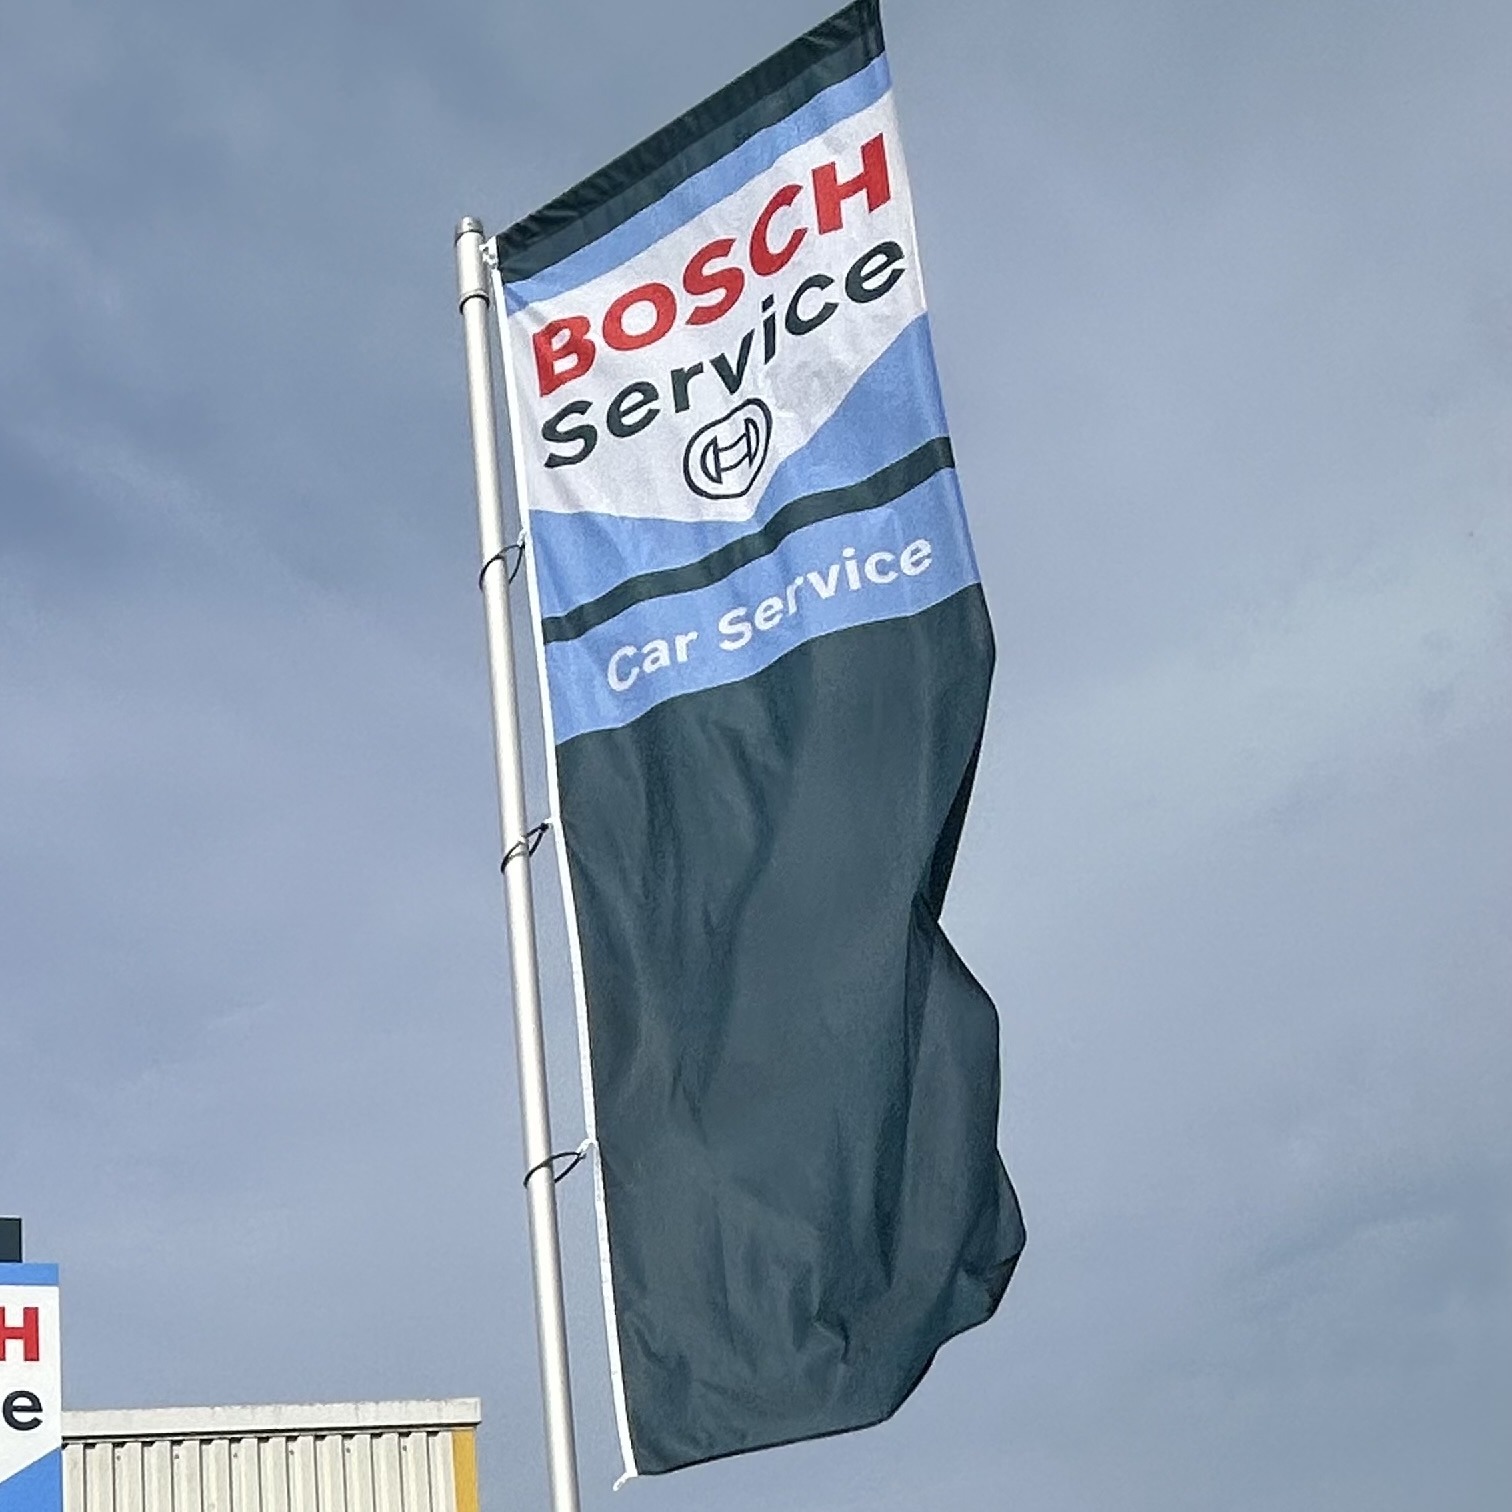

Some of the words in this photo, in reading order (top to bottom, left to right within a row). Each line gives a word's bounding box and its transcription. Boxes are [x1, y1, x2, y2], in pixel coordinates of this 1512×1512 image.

[532, 132, 892, 396] BOSCH
[542, 240, 906, 468] Service
[607, 630, 699, 693] Car
[718, 537, 933, 652] Service
